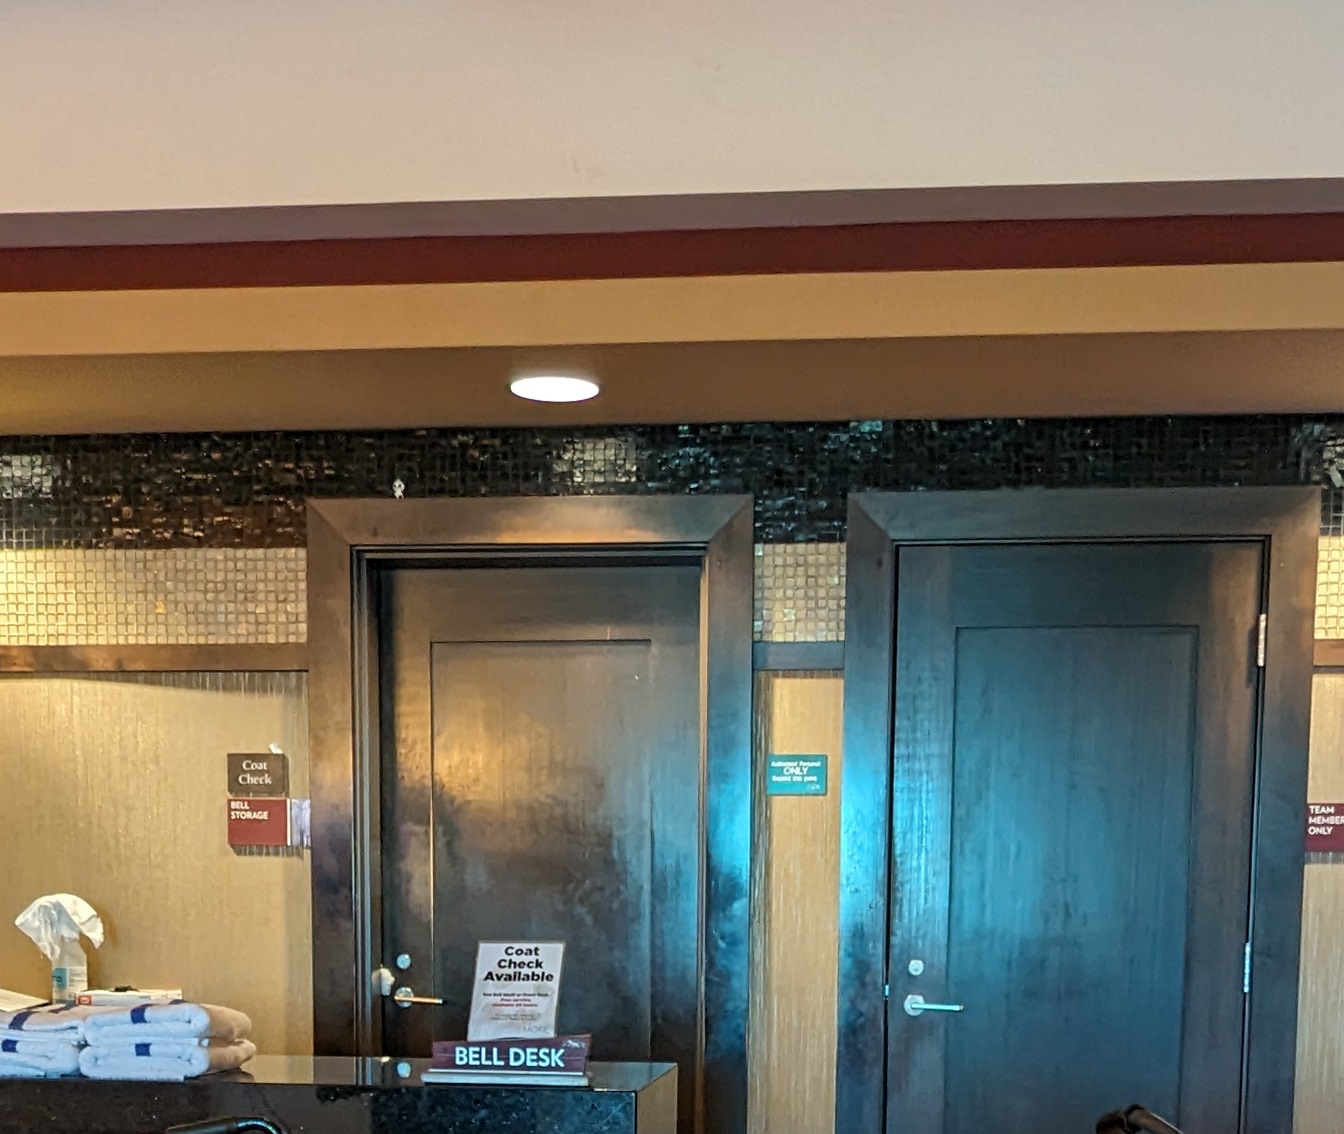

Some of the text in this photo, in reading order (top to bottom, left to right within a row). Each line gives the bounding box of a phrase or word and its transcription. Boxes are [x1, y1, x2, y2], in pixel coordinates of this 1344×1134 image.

[242, 760, 268, 771] Coat
[783, 766, 809, 775] ONLY
[238, 773, 272, 785] Check
[230, 801, 250, 810] BELL
[1308, 805, 1335, 814] TEAM
[230, 811, 269, 820] STORAGE
[1307, 826, 1334, 836] ONLY
[504, 945, 541, 957] Coat
[497, 958, 544, 970] Check
[483, 971, 555, 982] Available
[455, 1046, 565, 1068] BELL DESK
